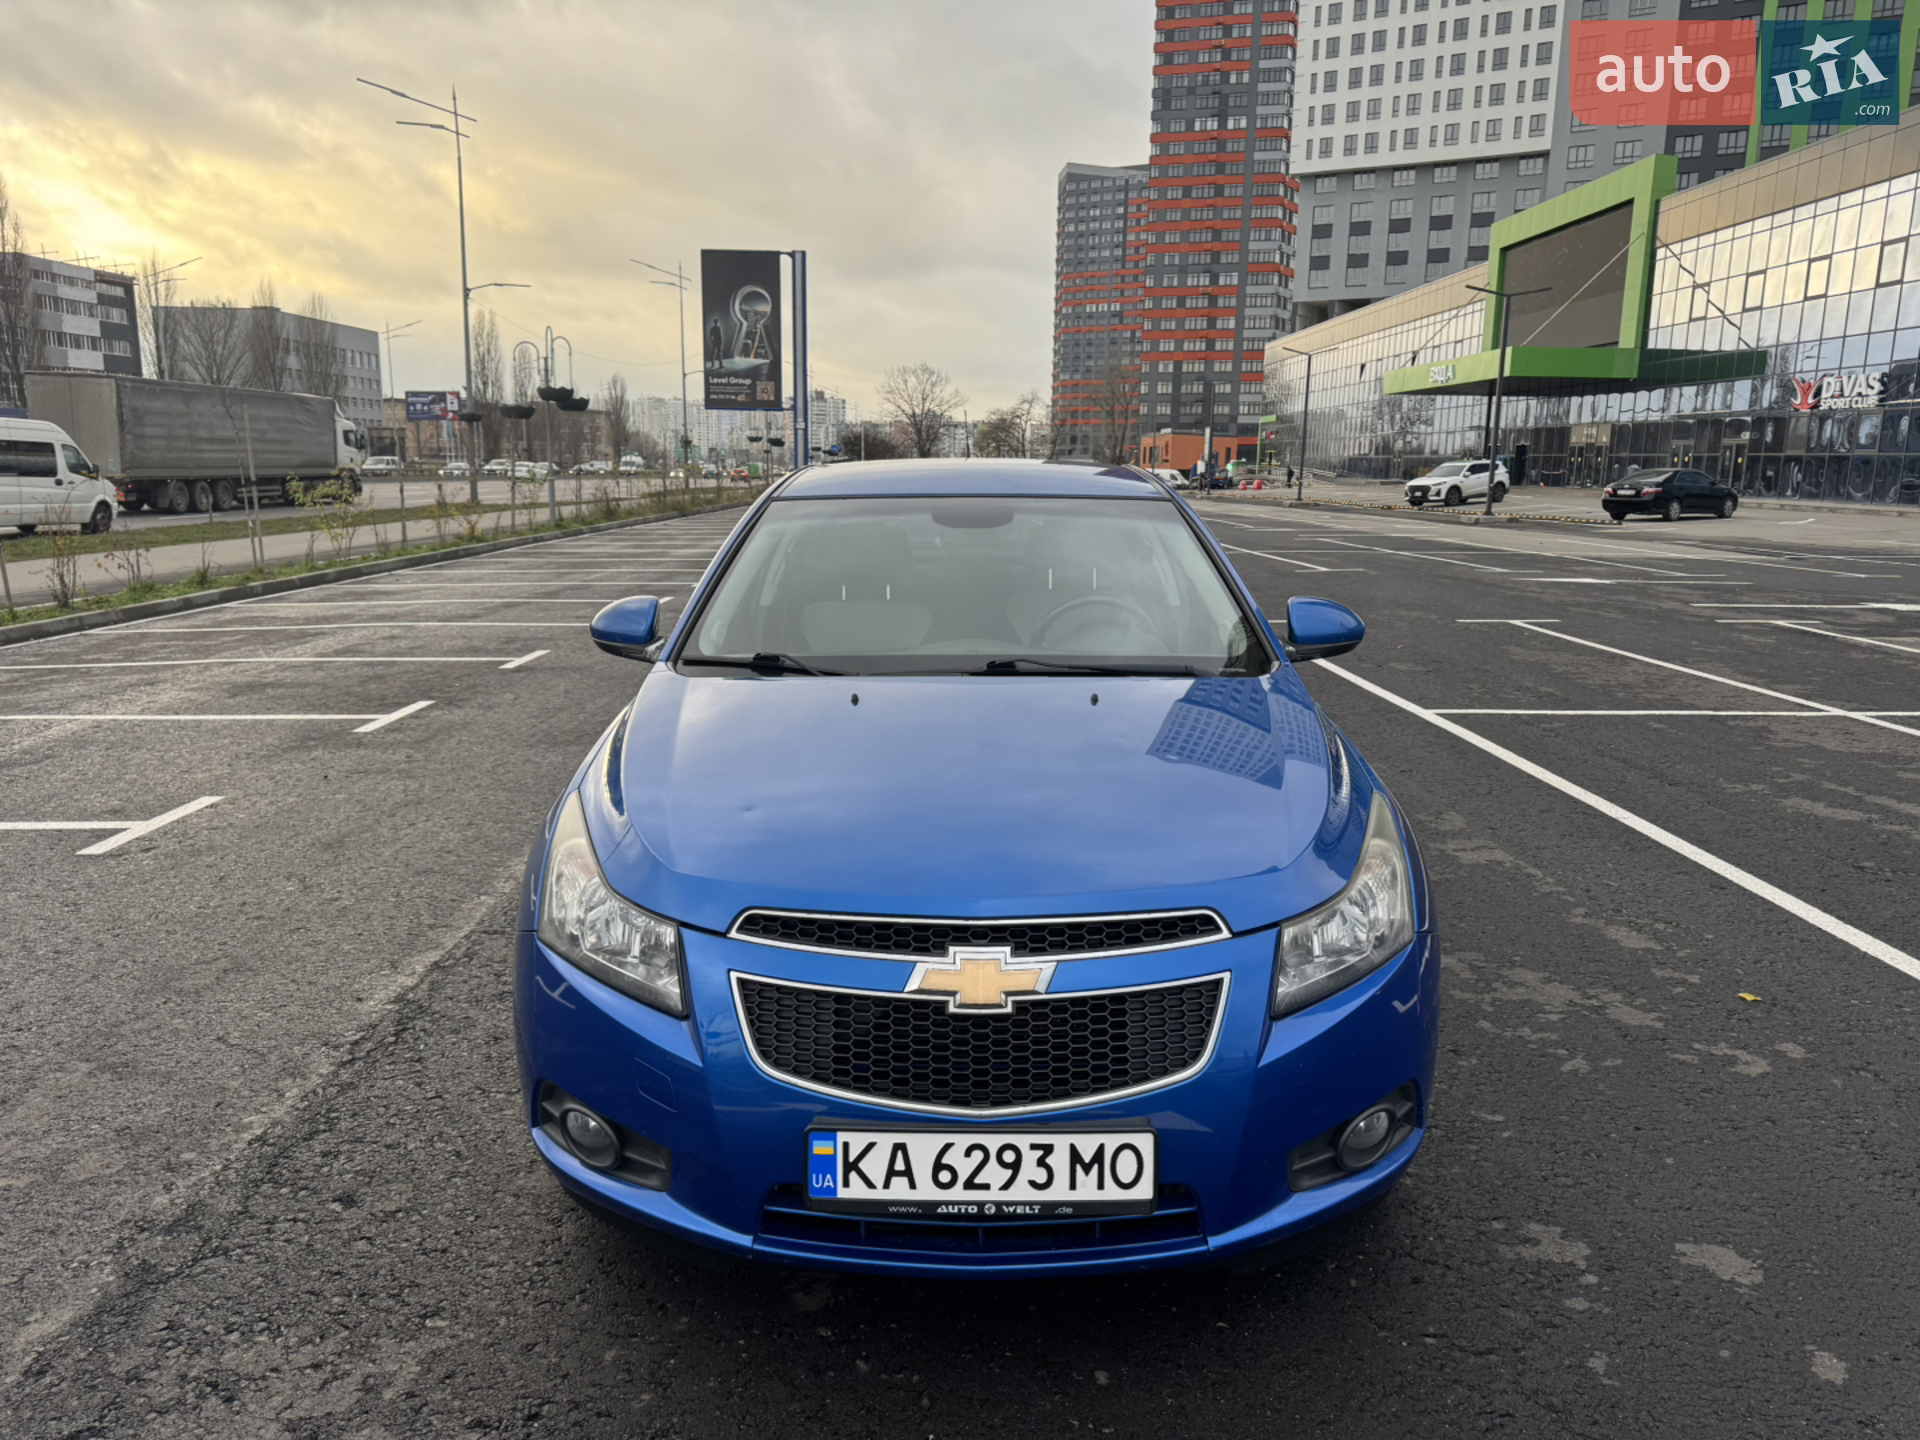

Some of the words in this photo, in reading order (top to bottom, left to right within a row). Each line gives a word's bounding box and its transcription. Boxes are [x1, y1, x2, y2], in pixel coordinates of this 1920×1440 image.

[709, 376, 728, 384] Level
[729, 376, 752, 385] Group
[1820, 398, 1850, 410] SPORT
[1851, 395, 1878, 409] CLUB
[841, 1141, 917, 1190] KA
[931, 1142, 1055, 1191] 6293
[1069, 1142, 1144, 1191] MO
[812, 1173, 835, 1189] UA
[888, 1205, 922, 1213] www.
[936, 1204, 978, 1214] AUTO
[1002, 1205, 1041, 1214] WELT
[1055, 1206, 1074, 1214] .de
